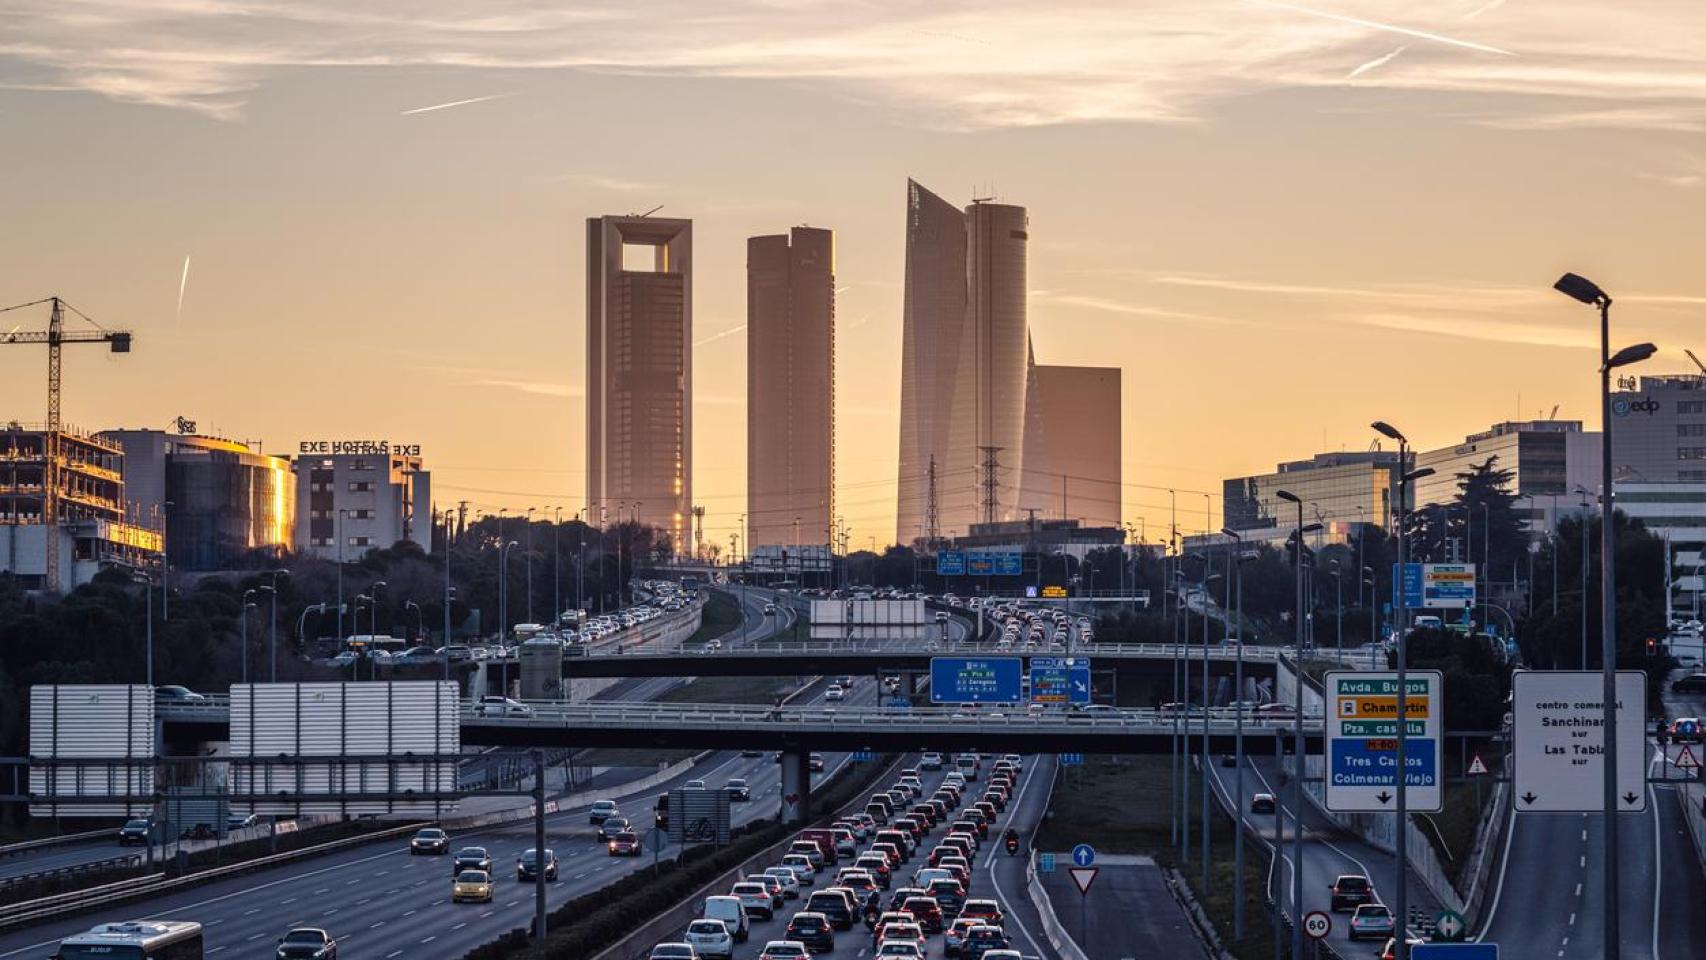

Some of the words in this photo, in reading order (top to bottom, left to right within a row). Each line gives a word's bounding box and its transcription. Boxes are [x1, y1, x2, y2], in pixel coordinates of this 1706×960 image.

[1631, 396, 1660, 416] edp
[299, 441, 328, 453] EXE
[1341, 682, 1377, 693] Avda.
[1383, 682, 1426, 694] Bugos
[1362, 702, 1427, 713] Chamrtin
[1536, 701, 1569, 709] centro
[1574, 701, 1623, 709] comeral
[1542, 716, 1617, 727] Sanchinar
[1343, 723, 1369, 734] Pza.
[1376, 723, 1423, 734] caslla
[1545, 744, 1566, 755] Las
[1573, 744, 1605, 755] Tabla
[1344, 756, 1371, 767] Tres
[1379, 756, 1423, 767] Catos
[1334, 773, 1394, 784] Colmenar
[1309, 920, 1326, 930] 60
